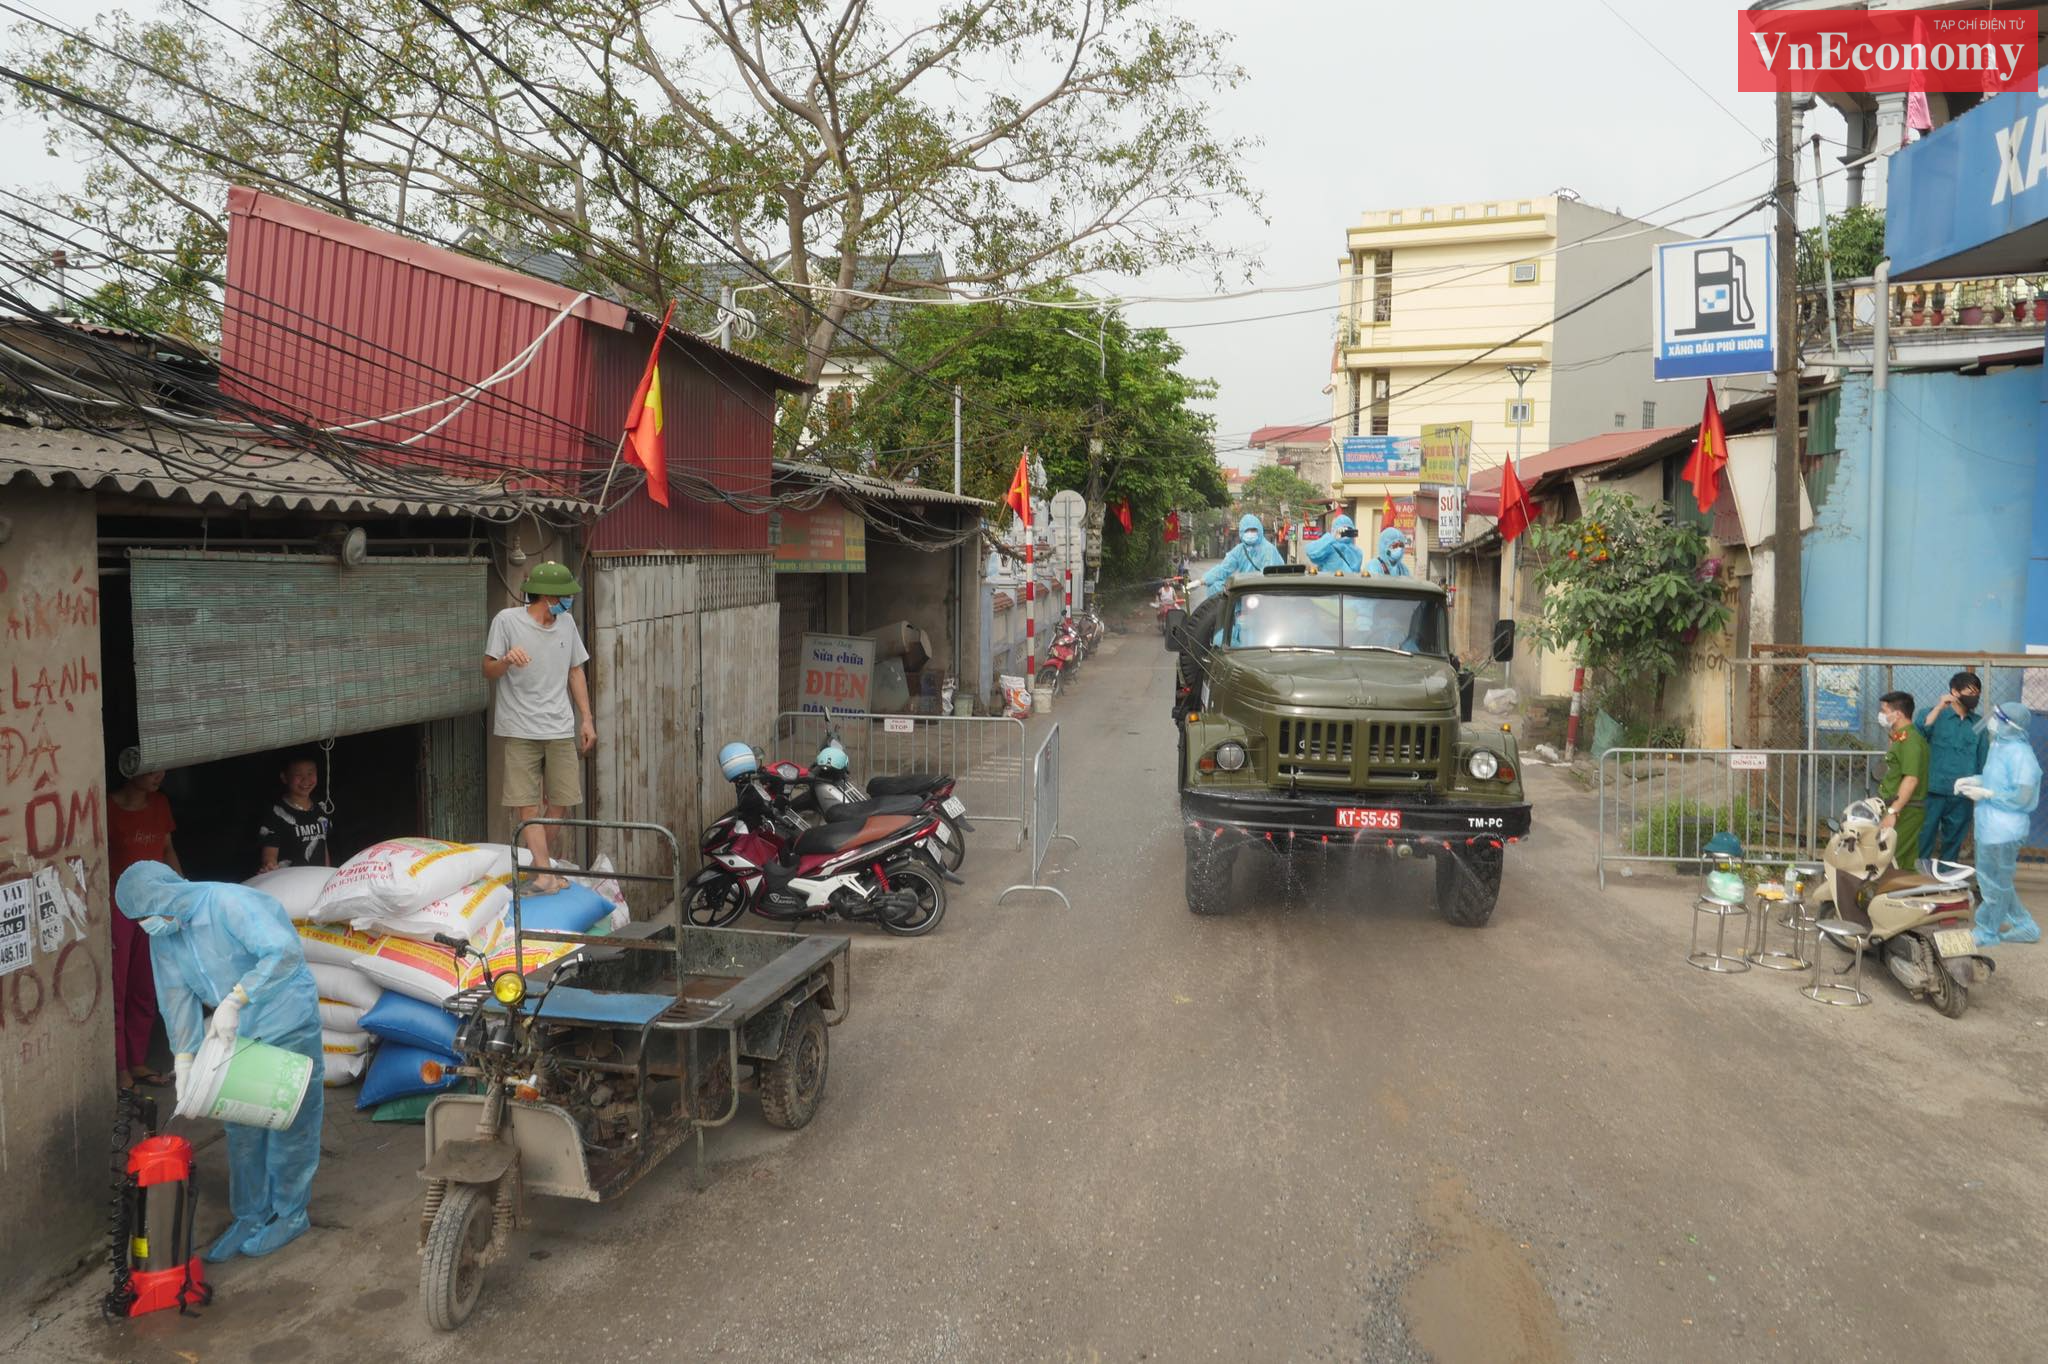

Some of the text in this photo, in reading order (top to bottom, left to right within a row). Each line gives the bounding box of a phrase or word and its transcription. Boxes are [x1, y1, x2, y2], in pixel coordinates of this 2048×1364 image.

[1668, 344, 1694, 357] XĂNG
[1737, 338, 1764, 351] HƯNG
[812, 648, 864, 666] Sửa chữa
[805, 664, 869, 703] ĐIỆN
[1338, 809, 1399, 828] KT-55-65
[1467, 817, 1504, 829] TM-PC
[3, 885, 23, 903] VAY
[3, 903, 25, 919] GÓP
[16, 920, 23, 932] 9
